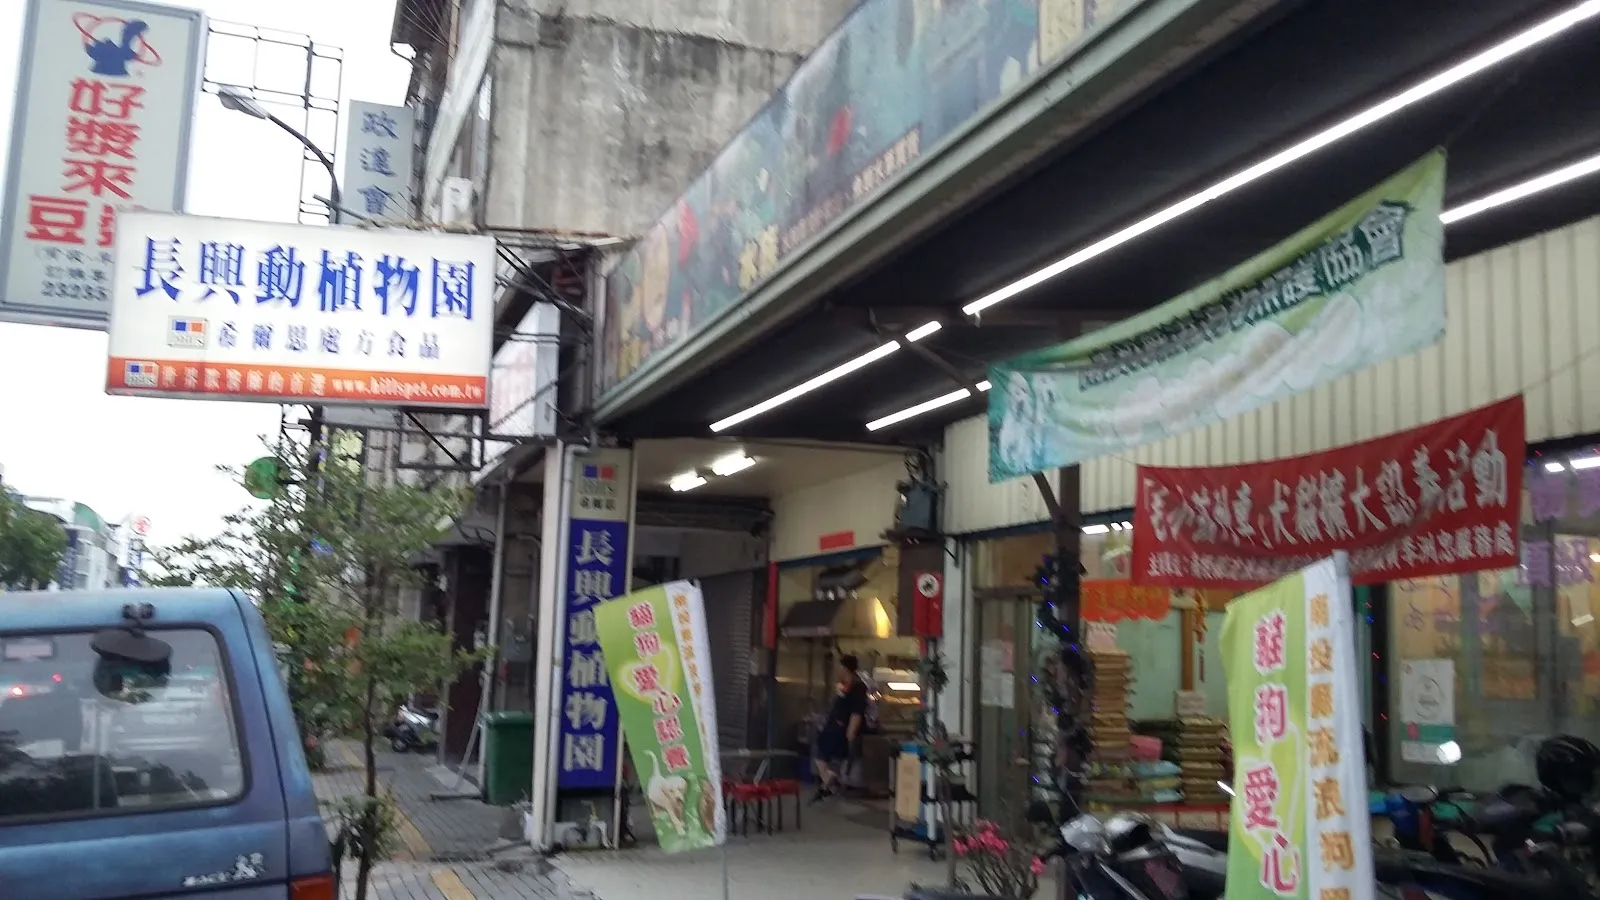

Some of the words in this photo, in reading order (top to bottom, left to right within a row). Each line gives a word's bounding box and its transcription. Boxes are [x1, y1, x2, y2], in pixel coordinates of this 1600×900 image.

[134, 235, 474, 320] 長興動植物園
[562, 529, 617, 772] 長興動植物園
